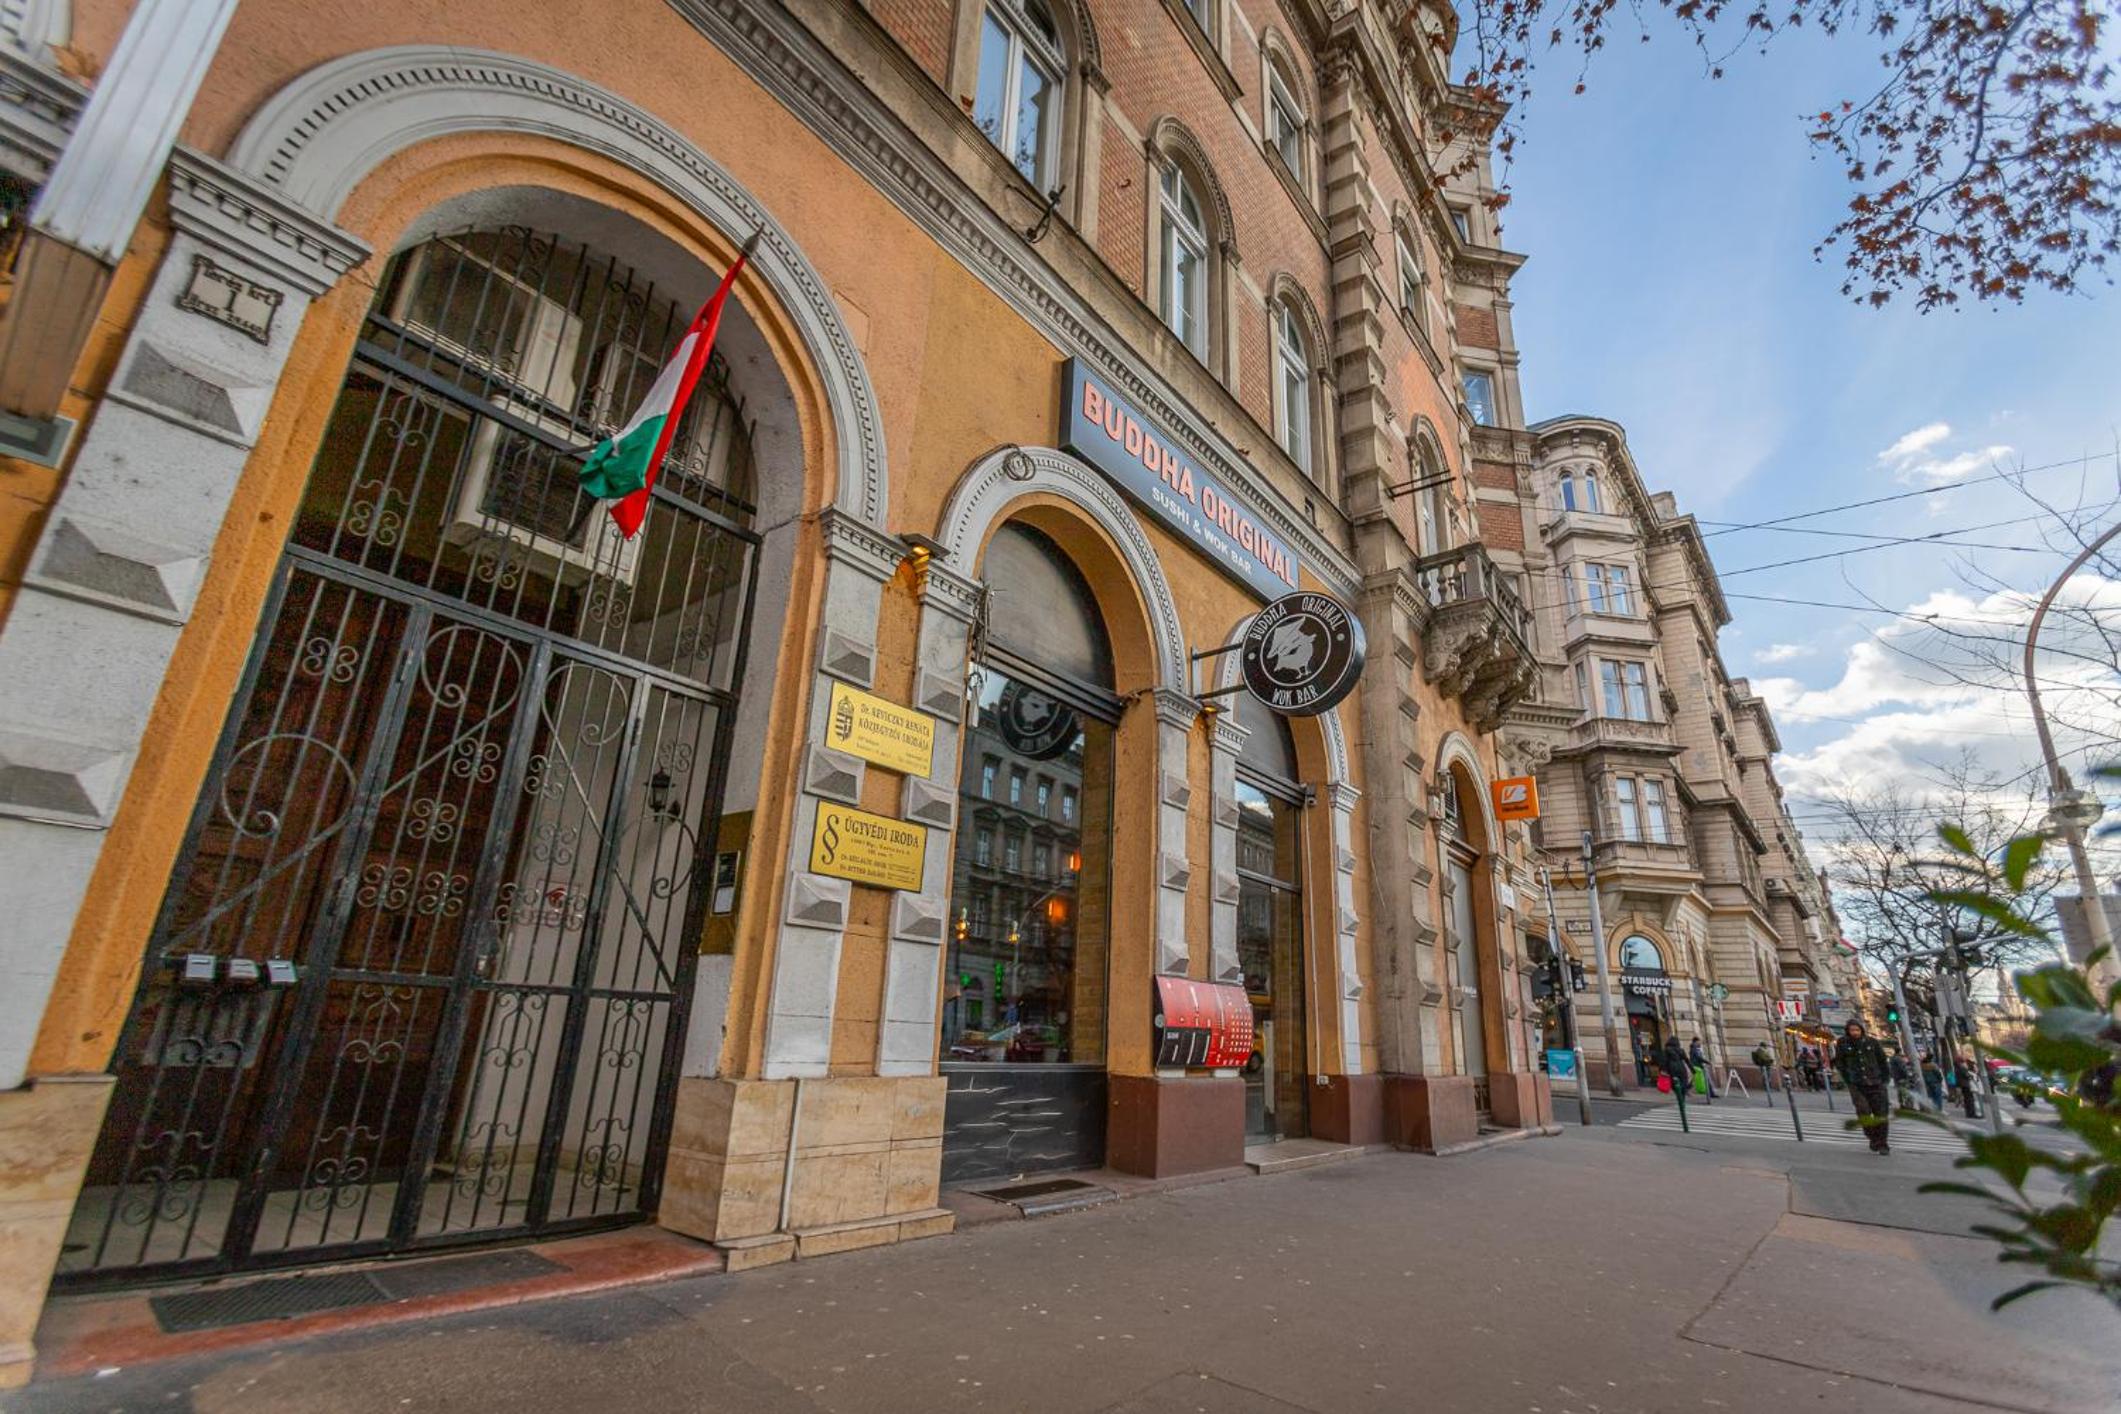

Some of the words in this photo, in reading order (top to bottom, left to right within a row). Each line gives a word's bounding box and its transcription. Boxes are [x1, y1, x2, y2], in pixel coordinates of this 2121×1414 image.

[1083, 380, 1196, 505] BUDDHA
[1201, 486, 1295, 590] ORIGINAL
[1152, 487, 1190, 526] SUSHI
[1193, 519, 1202, 536] &
[1204, 528, 1229, 555] WOK
[1231, 550, 1253, 576] BAR
[1248, 602, 1288, 640] BUDDHA
[1301, 596, 1346, 632] ORIGINAL
[1272, 688, 1293, 707] WOK
[1297, 684, 1319, 704] BAR
[890, 829, 919, 849] IRODA
